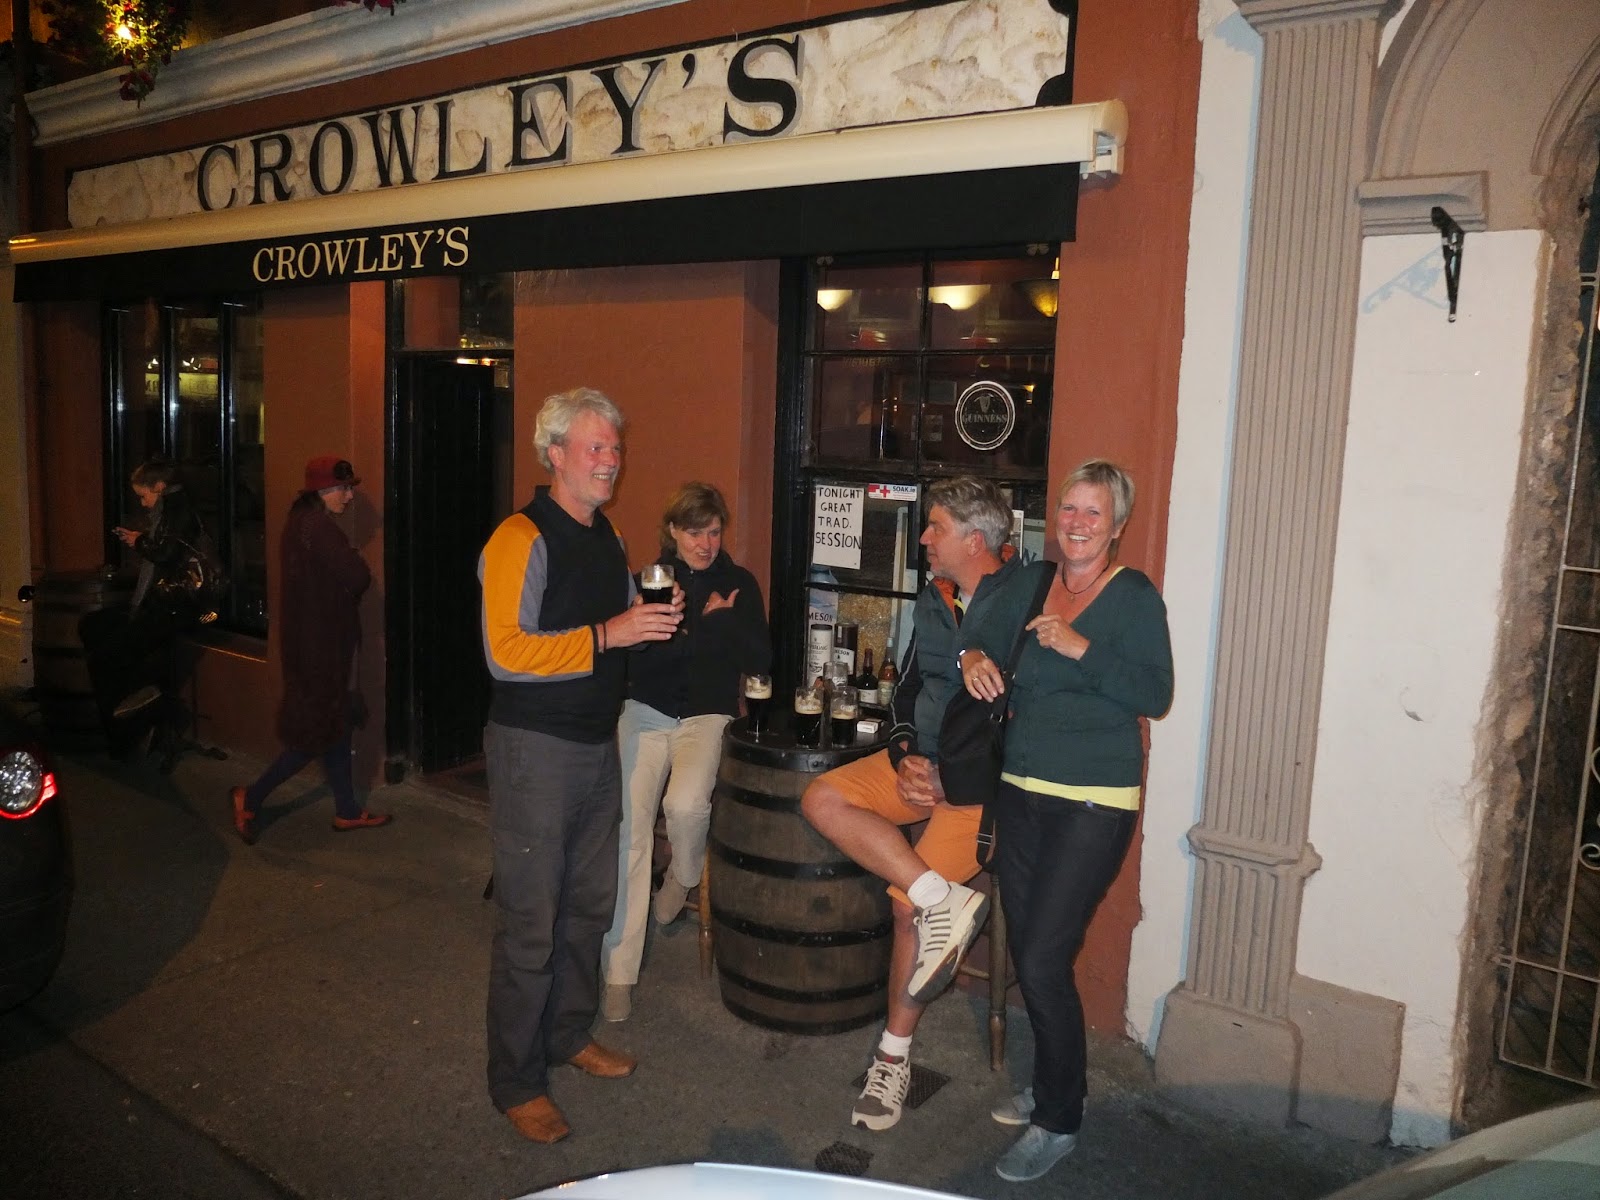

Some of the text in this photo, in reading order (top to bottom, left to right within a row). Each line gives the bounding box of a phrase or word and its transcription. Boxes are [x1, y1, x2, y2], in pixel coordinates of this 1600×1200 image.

[197, 34, 803, 211] CROWLEY'S
[252, 226, 469, 282] CROWLEY'S
[963, 413, 1008, 424] GUINNESS
[819, 487, 862, 499] TONIGHT
[820, 501, 853, 513] GREAT
[818, 516, 852, 529] TRAD.
[815, 531, 861, 550] SESSION
